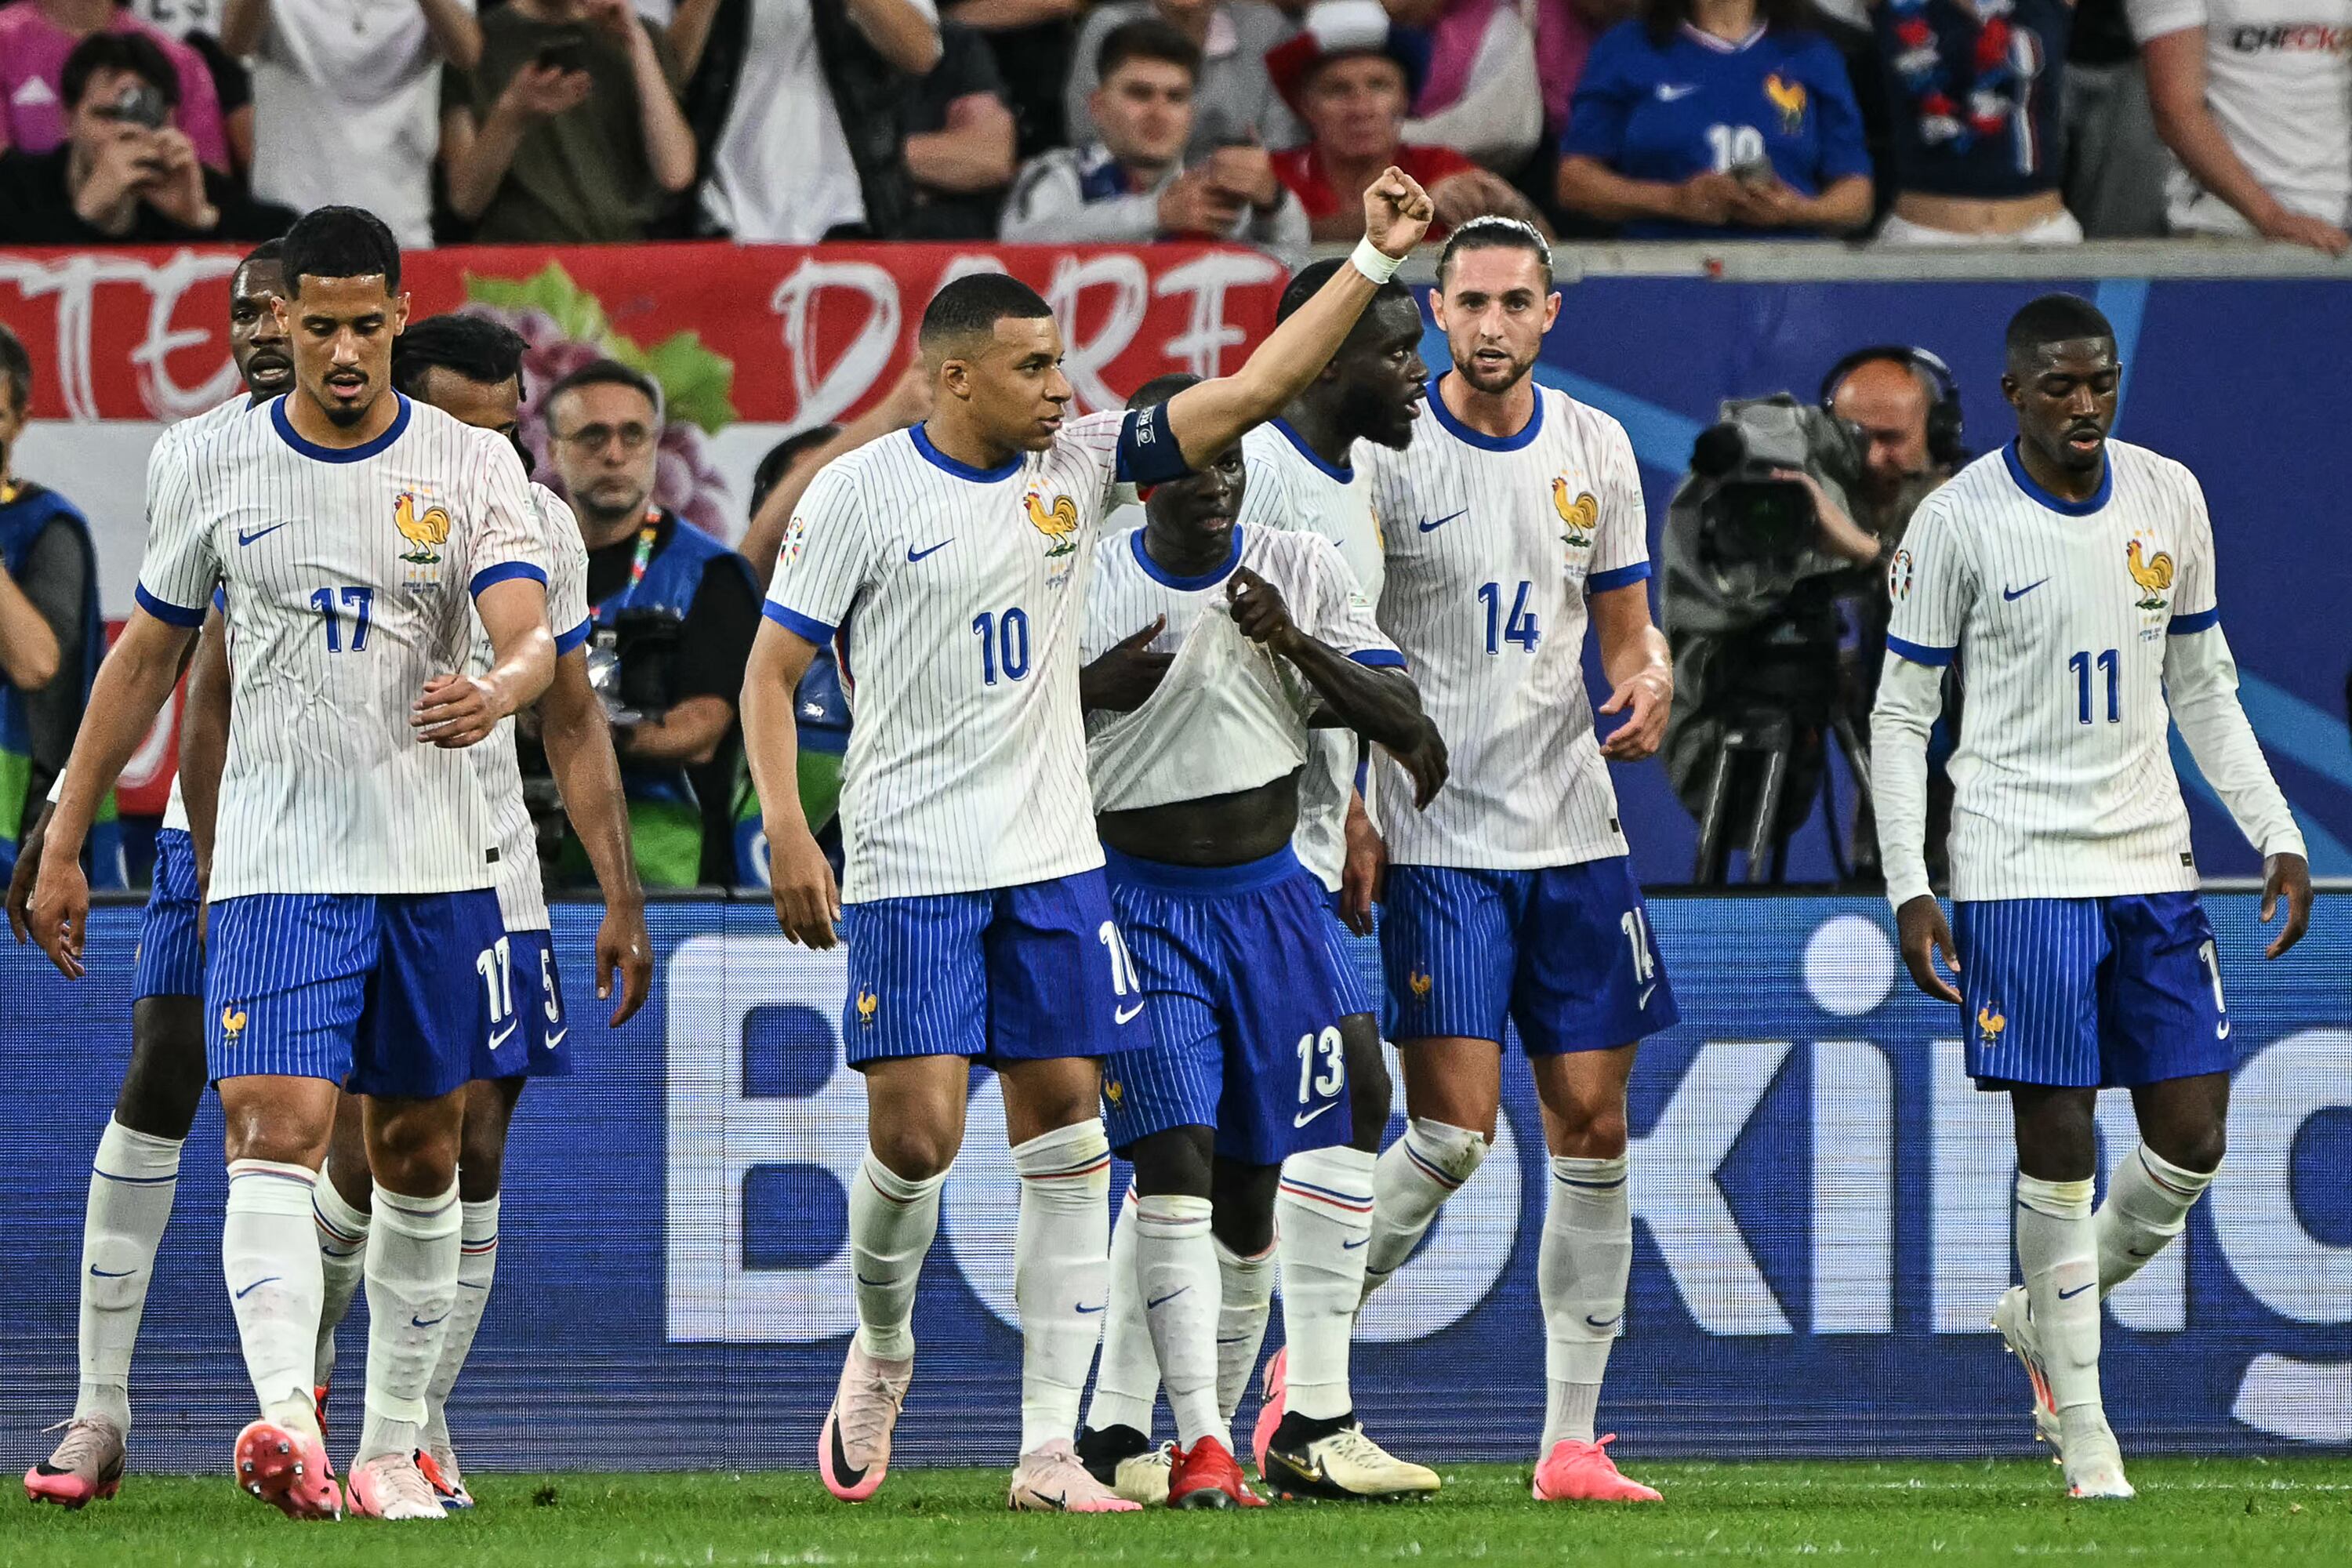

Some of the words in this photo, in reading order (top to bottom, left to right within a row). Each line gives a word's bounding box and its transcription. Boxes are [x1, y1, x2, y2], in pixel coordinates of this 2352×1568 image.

[1706, 123, 1766, 175] 10
[310, 586, 374, 652] 17
[972, 607, 1031, 685] 10
[1477, 581, 1542, 655] 14
[2068, 648, 2121, 725] 11
[476, 936, 510, 1024] 17
[1621, 906, 1653, 984] 14
[541, 949, 559, 1023] 5
[1297, 1025, 1345, 1103] 13
[665, 914, 2352, 1441] Bkin
